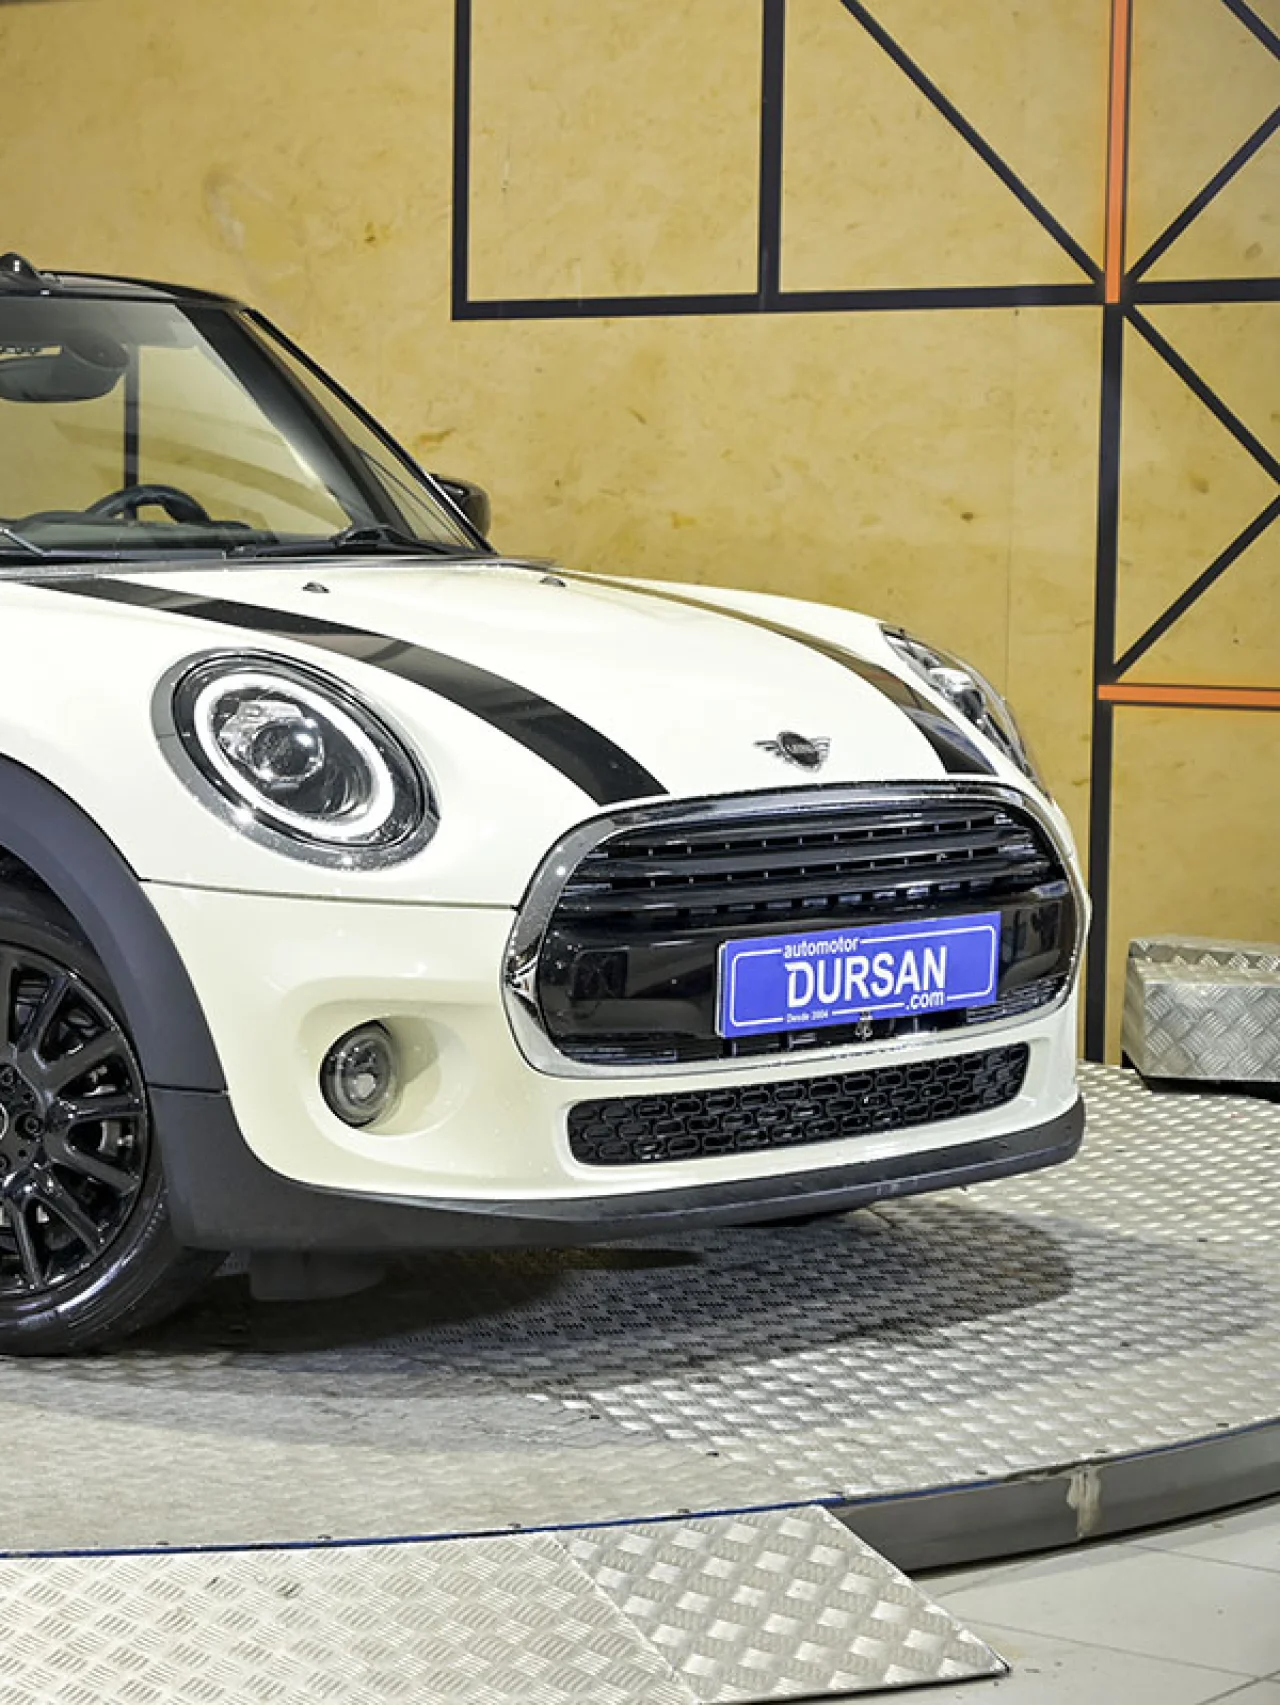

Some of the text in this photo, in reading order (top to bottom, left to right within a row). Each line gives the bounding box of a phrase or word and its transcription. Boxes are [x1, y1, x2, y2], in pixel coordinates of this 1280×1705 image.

[783, 936, 860, 958] automotor
[783, 945, 948, 1009] DURSAN
[905, 991, 945, 1011] .com
